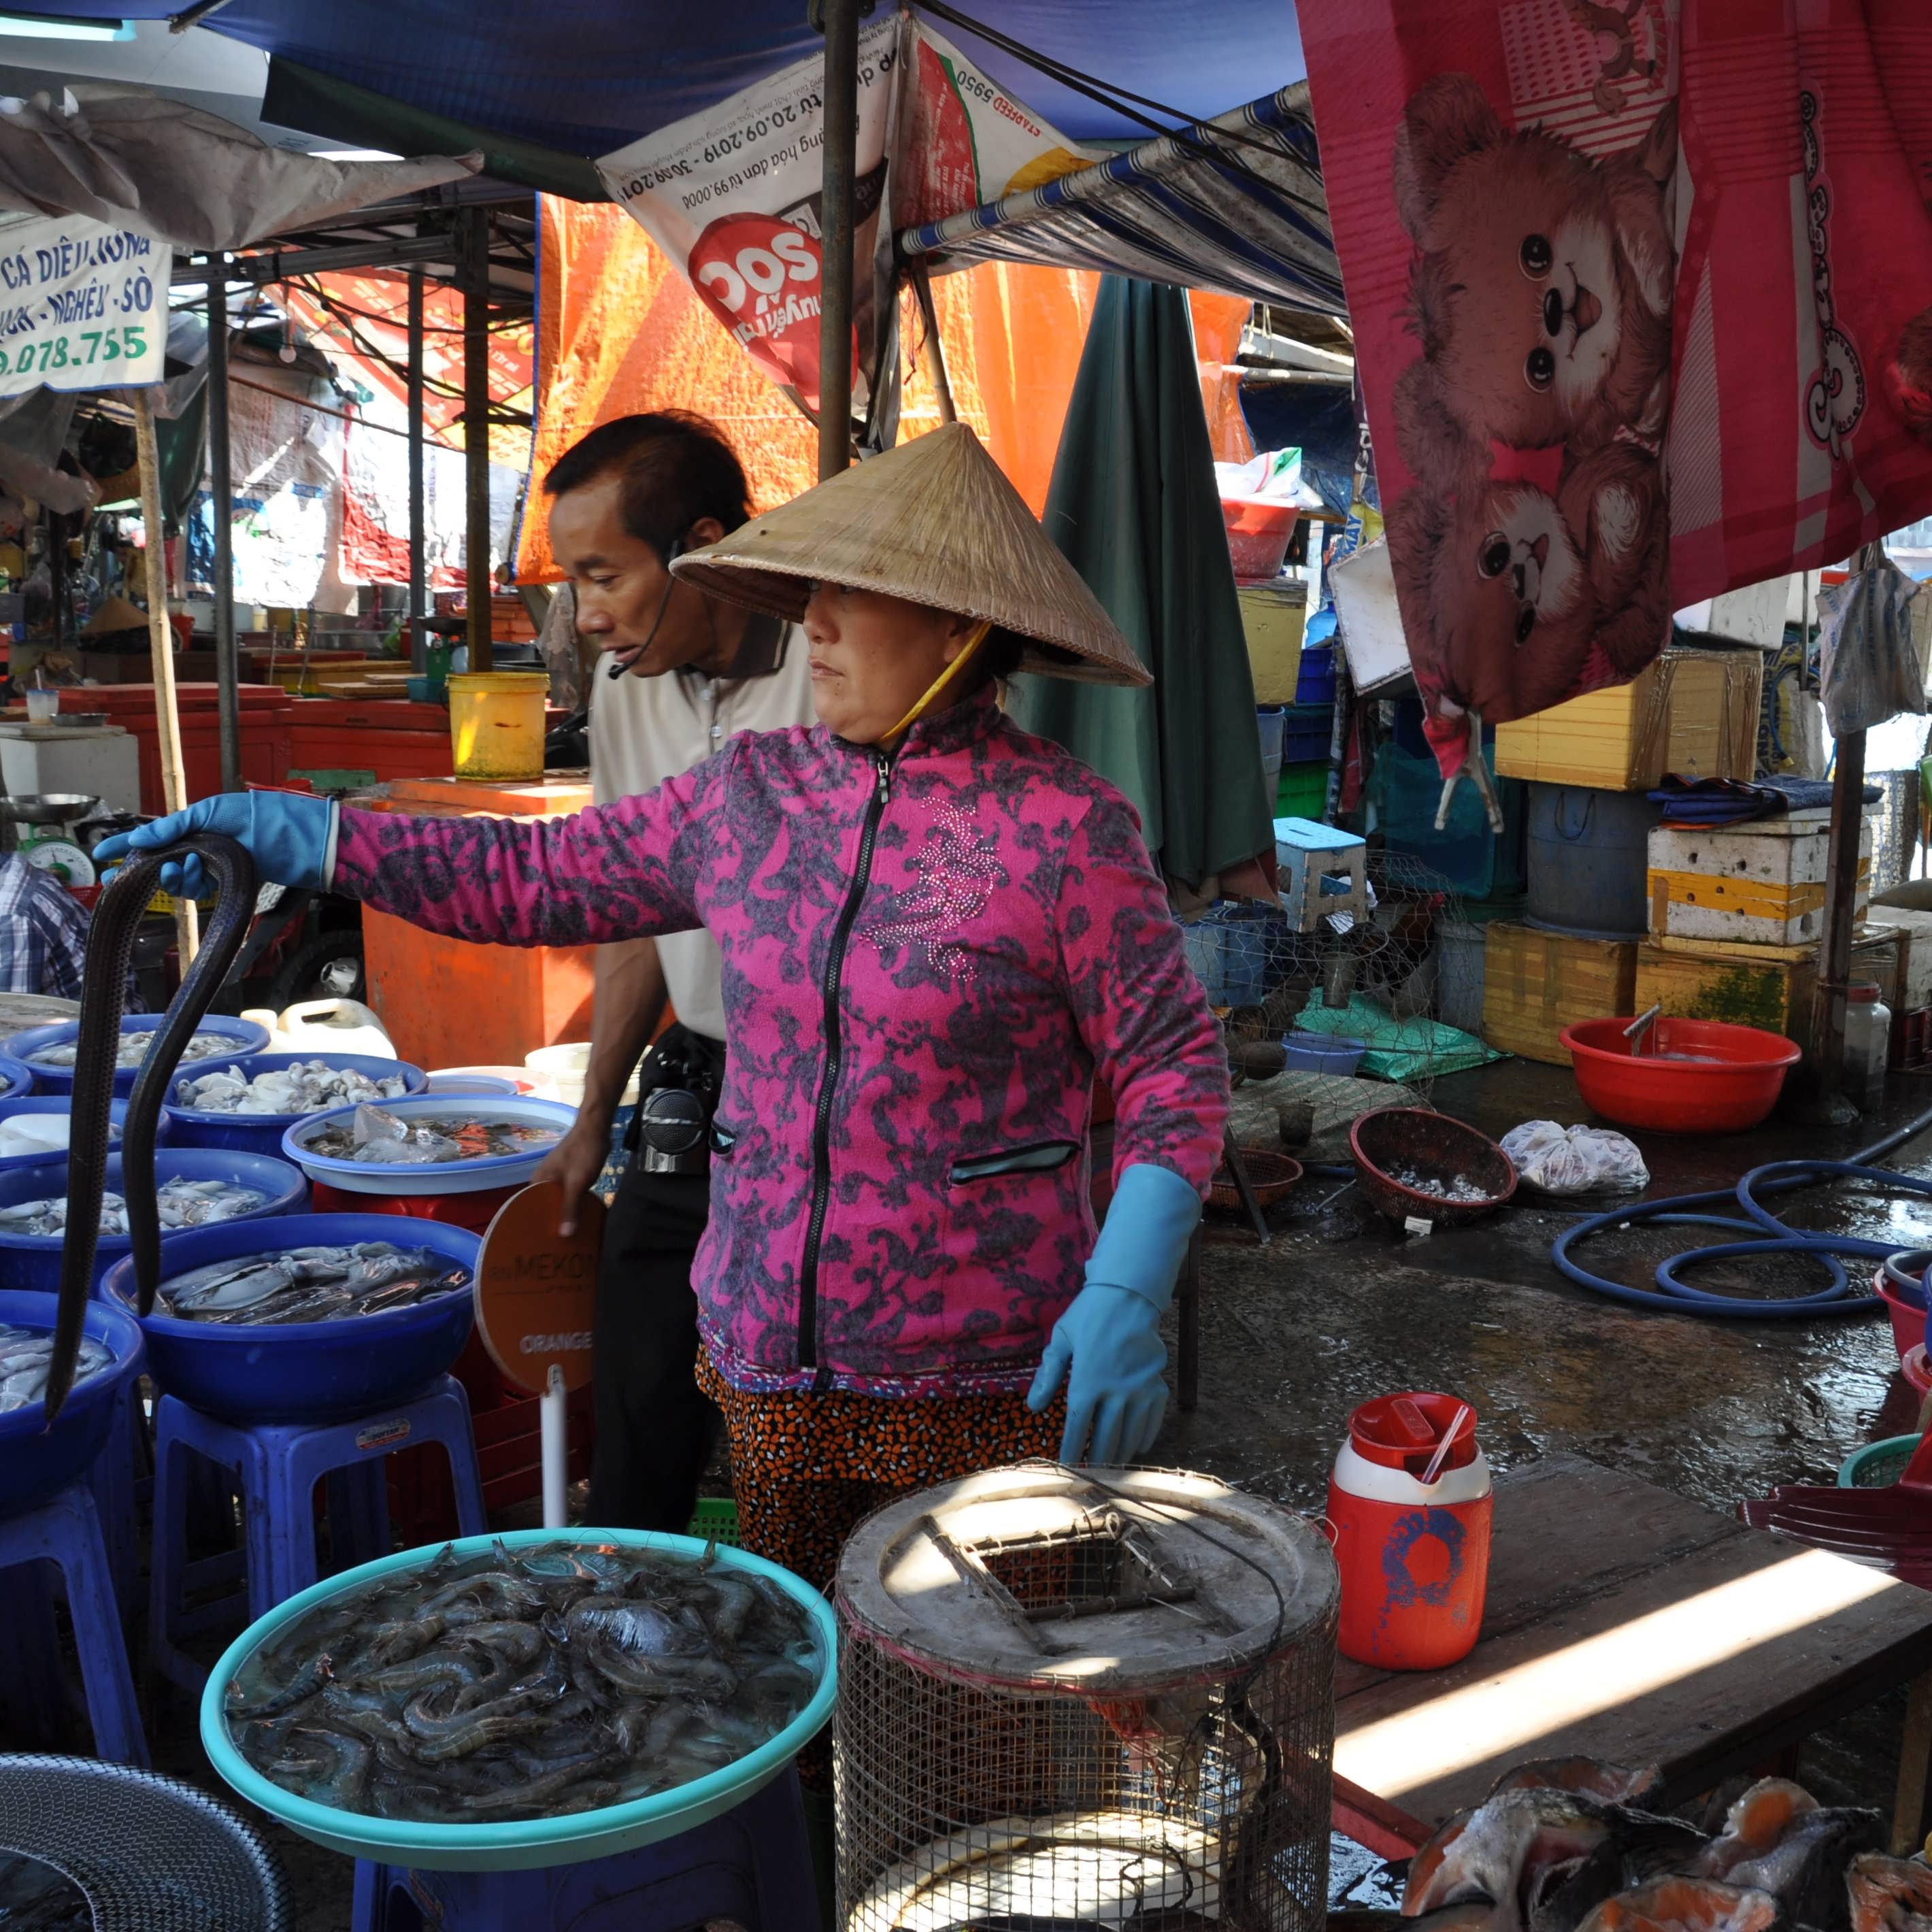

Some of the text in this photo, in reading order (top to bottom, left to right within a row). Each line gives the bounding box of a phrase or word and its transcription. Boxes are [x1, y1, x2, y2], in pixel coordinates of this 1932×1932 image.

[956, 70, 994, 103] 5950
[704, 105, 796, 163] 20.09.2019
[742, 158, 769, 180] đơn
[770, 145, 799, 167] hóa
[682, 179, 730, 210] 99.000đ
[1, 245, 31, 289] CÁ
[47, 278, 110, 326] NGHÊU
[121, 266, 153, 312] SÒ
[520, 1331, 593, 1354] ORANGE
